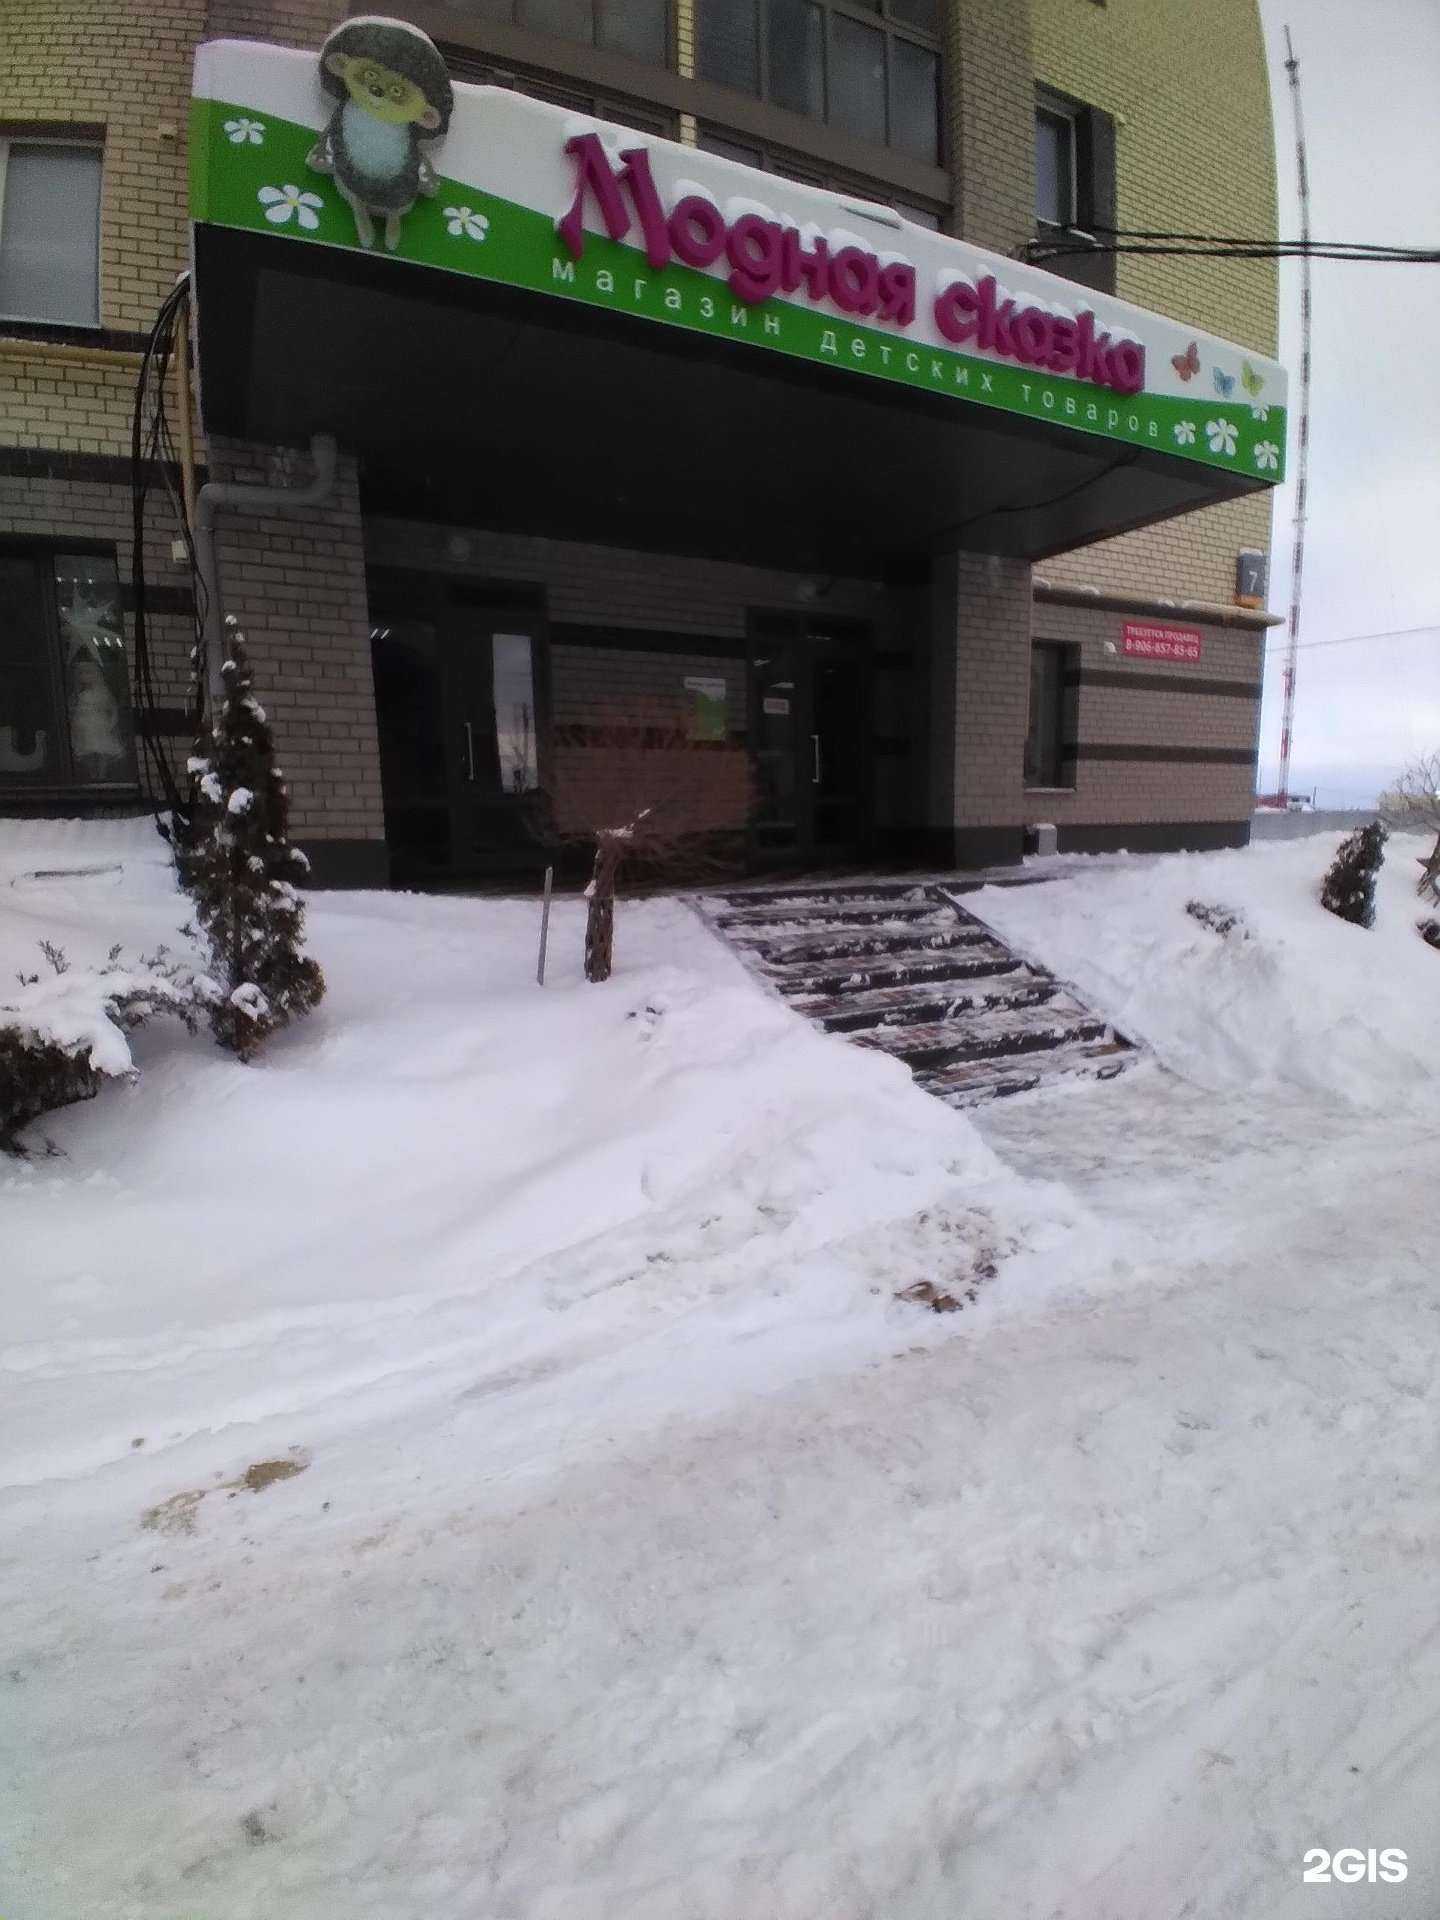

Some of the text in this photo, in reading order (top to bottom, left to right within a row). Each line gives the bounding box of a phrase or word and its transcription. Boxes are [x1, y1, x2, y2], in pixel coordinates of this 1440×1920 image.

[560, 133, 915, 328] Модная
[552, 257, 1159, 437] магазин детских товаров
